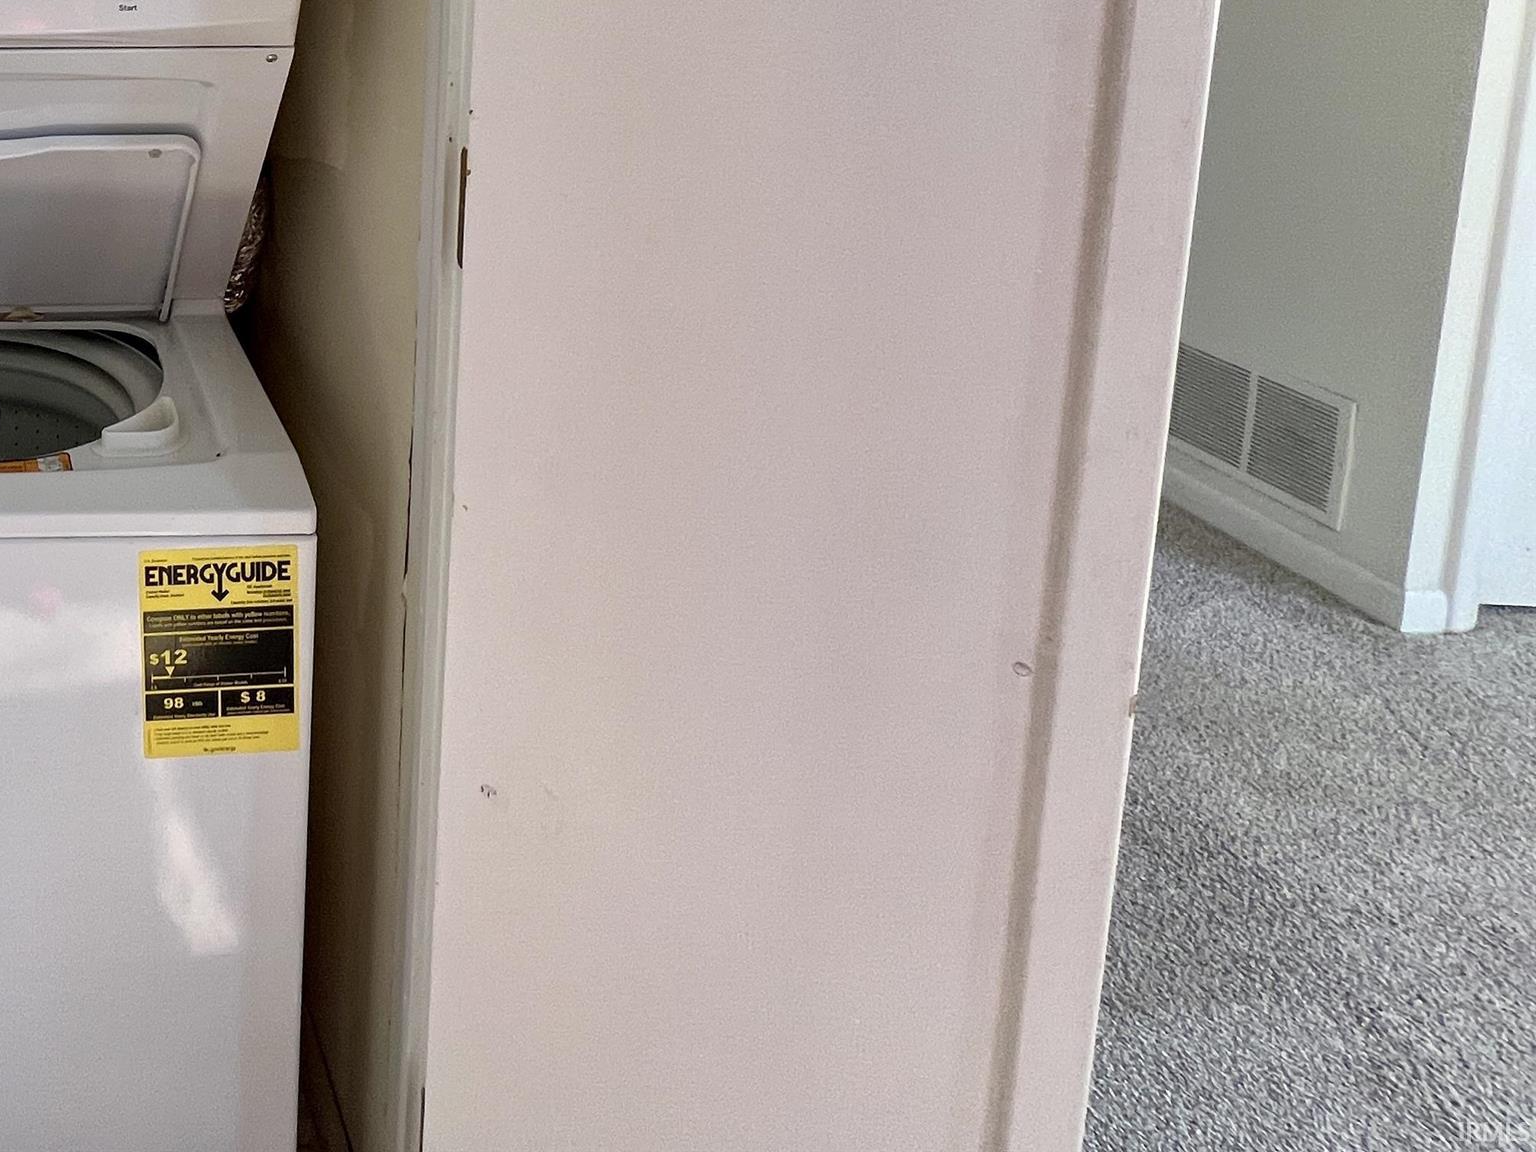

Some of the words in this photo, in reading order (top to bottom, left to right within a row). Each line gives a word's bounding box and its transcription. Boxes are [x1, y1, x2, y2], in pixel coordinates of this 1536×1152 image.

[145, 560, 292, 588] ENERGYGUIDE
[149, 649, 188, 666] $12
[164, 697, 184, 709] 98
[240, 691, 251, 703] $
[256, 690, 266, 702] 8
